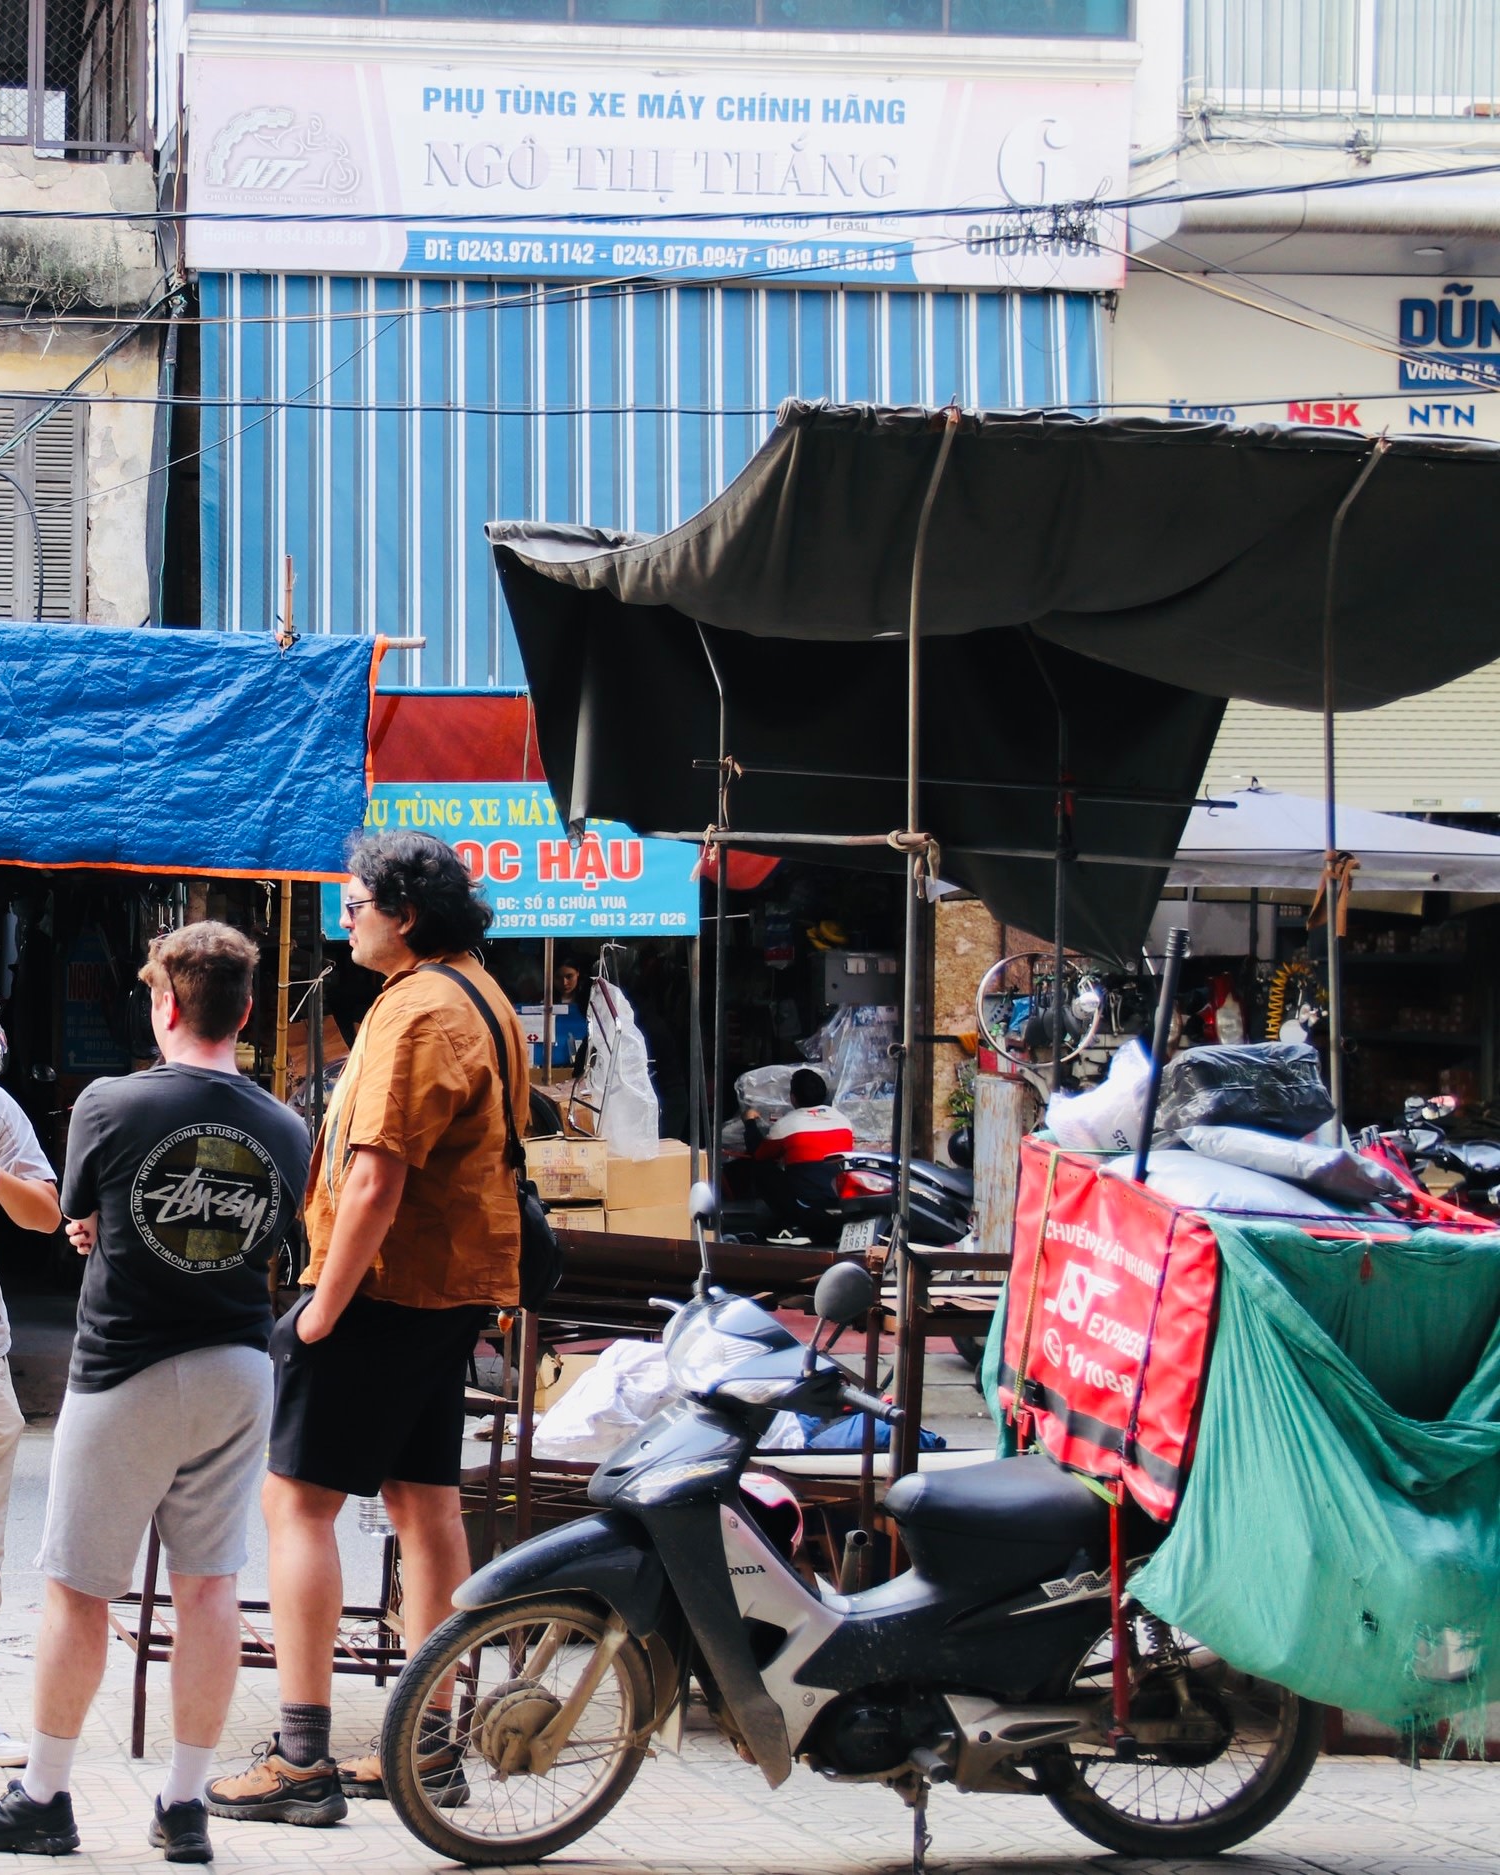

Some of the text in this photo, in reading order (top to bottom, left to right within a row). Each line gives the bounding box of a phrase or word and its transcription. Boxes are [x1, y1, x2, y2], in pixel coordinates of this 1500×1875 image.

[422, 84, 906, 125] PHỤ TÙNG XE MÁY CHÍNH HÃNG
[423, 131, 899, 203] NGÔ THỊ THẮNG
[424, 238, 452, 261] ĐT:
[457, 239, 594, 265] 0243.978.1142
[612, 243, 749, 269] 0243.976.0947
[1287, 400, 1362, 427] NSK
[1409, 404, 1475, 427] NTN
[395, 791, 463, 826] TÙNG
[469, 798, 501, 826] XE
[507, 791, 557, 826] MÁY
[537, 830, 644, 891] HẬU
[496, 892, 627, 911] ĐC: SỐ 8 CHÙA VUA
[541, 913, 576, 927] 0587
[590, 913, 625, 927] 0913
[629, 912, 656, 926] 237
[660, 912, 687, 926] 026
[139, 1126, 270, 1181] INTERNATIONAL STUSSY TRIBE
[260, 1169, 279, 1233] WORLD WIDE
[134, 1189, 193, 1270] KNOWLEDGE IS KING
[219, 1253, 244, 1268] INCE
[1086, 1312, 1145, 1360] EXPRES
[1085, 1361, 1134, 1398] 1088
[727, 1564, 766, 1576] ONDA
